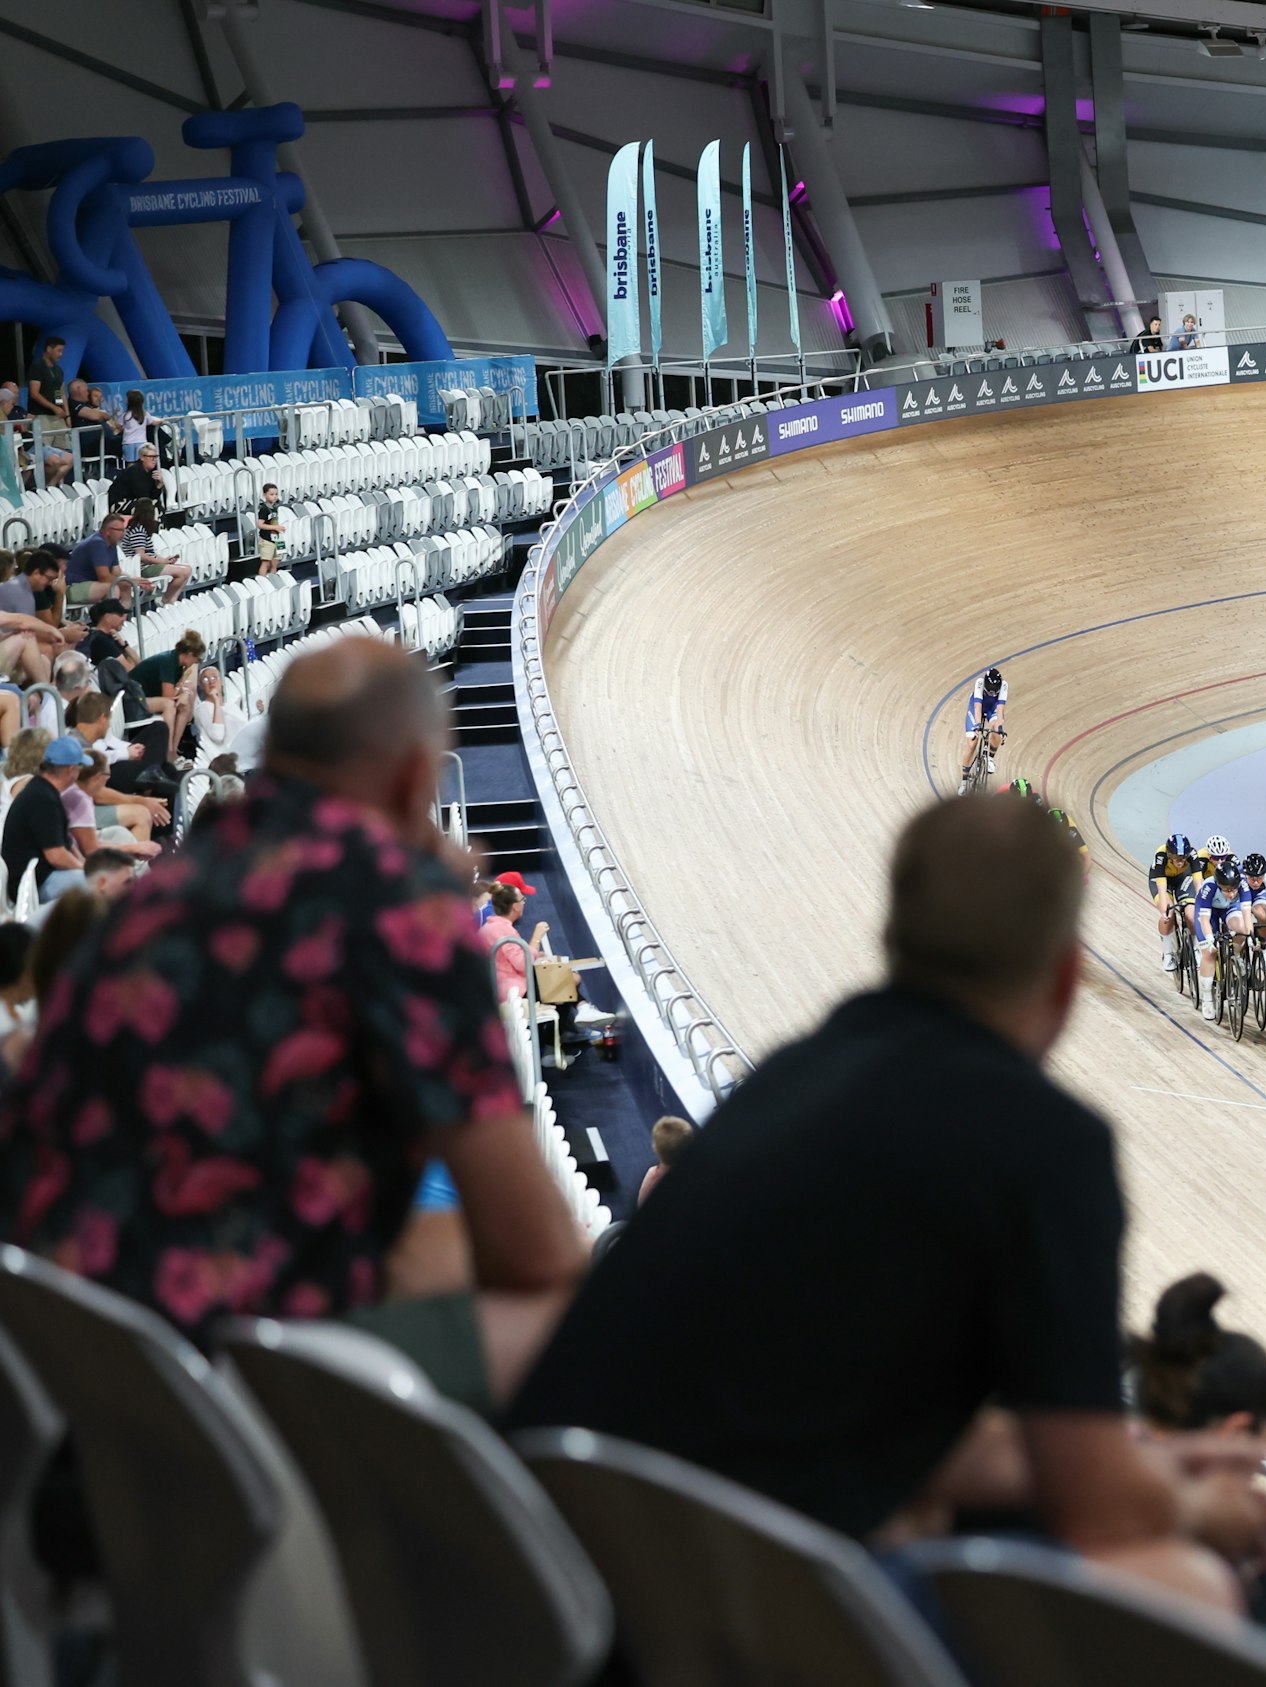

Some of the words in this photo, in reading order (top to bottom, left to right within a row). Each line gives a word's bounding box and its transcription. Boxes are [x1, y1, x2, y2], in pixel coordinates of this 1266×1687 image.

[129, 194, 176, 212] BRISBANE
[177, 190, 216, 209] CYCLING
[217, 187, 261, 205] FESTIVAL
[613, 211, 628, 299] brisbane
[953, 296, 972, 304] HOSE
[1147, 358, 1184, 383] UCI
[1187, 363, 1209, 371] CYCLISTE
[1187, 370, 1228, 379] INTERNATIONALE
[294, 379, 340, 402] CYCLING
[374, 374, 419, 396] CYCLING
[435, 370, 476, 391] CYCLING
[145, 390, 203, 413] CYCLING
[224, 383, 275, 408] CYCLING
[841, 401, 885, 425] SHIMANO
[778, 415, 818, 440] SHIMANO
[654, 452, 684, 493] FESTIVAL
